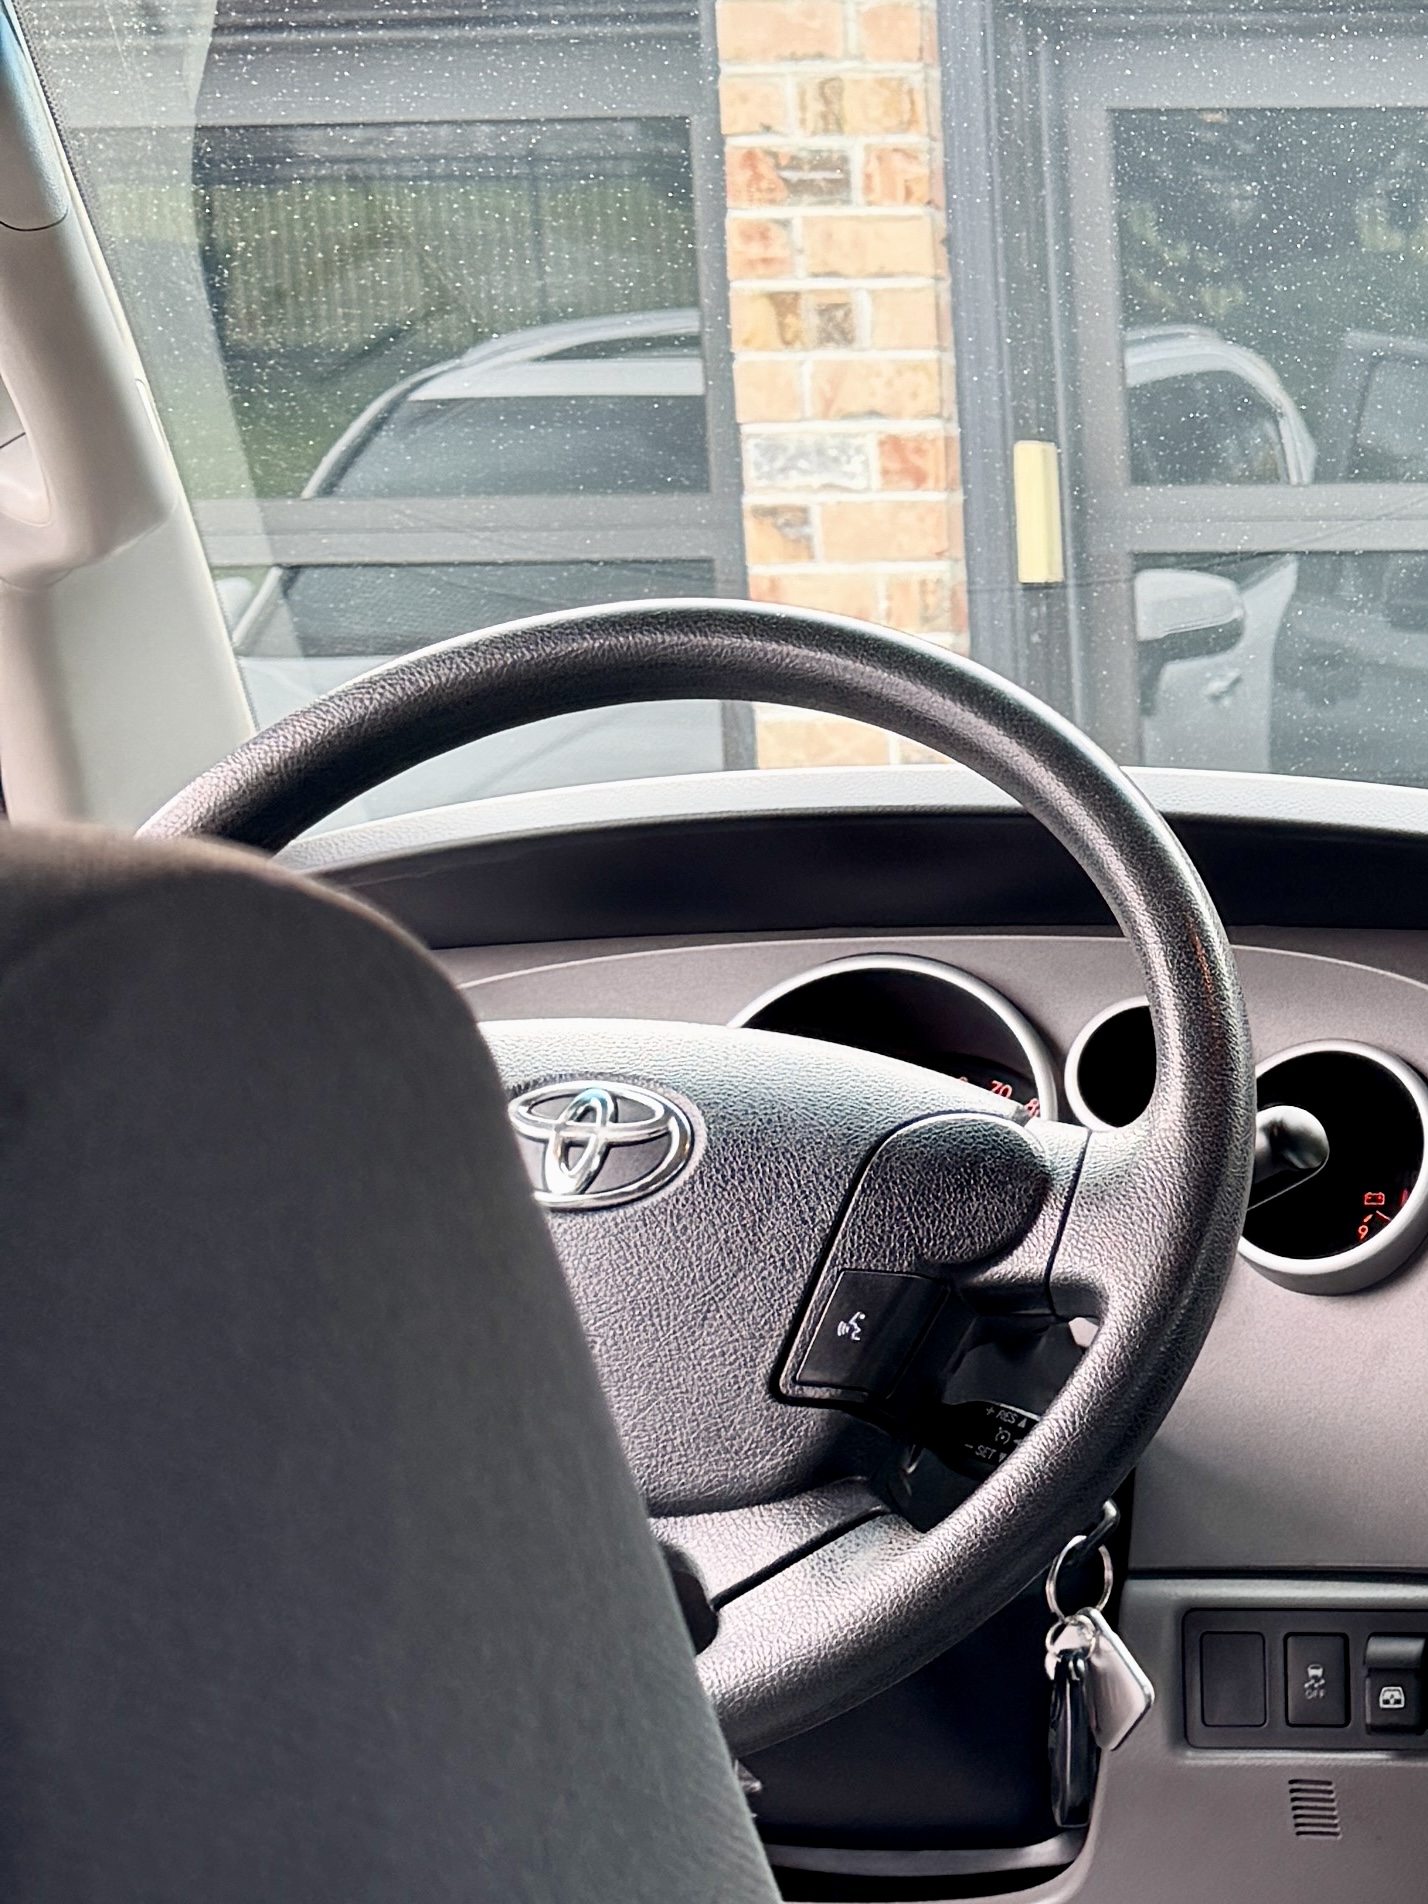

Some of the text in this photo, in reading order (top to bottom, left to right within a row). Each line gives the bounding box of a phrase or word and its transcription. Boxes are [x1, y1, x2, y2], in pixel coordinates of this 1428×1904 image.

[989, 1080, 1013, 1099] 70
[996, 1409, 1019, 1424] RES
[975, 1444, 997, 1460] SET
